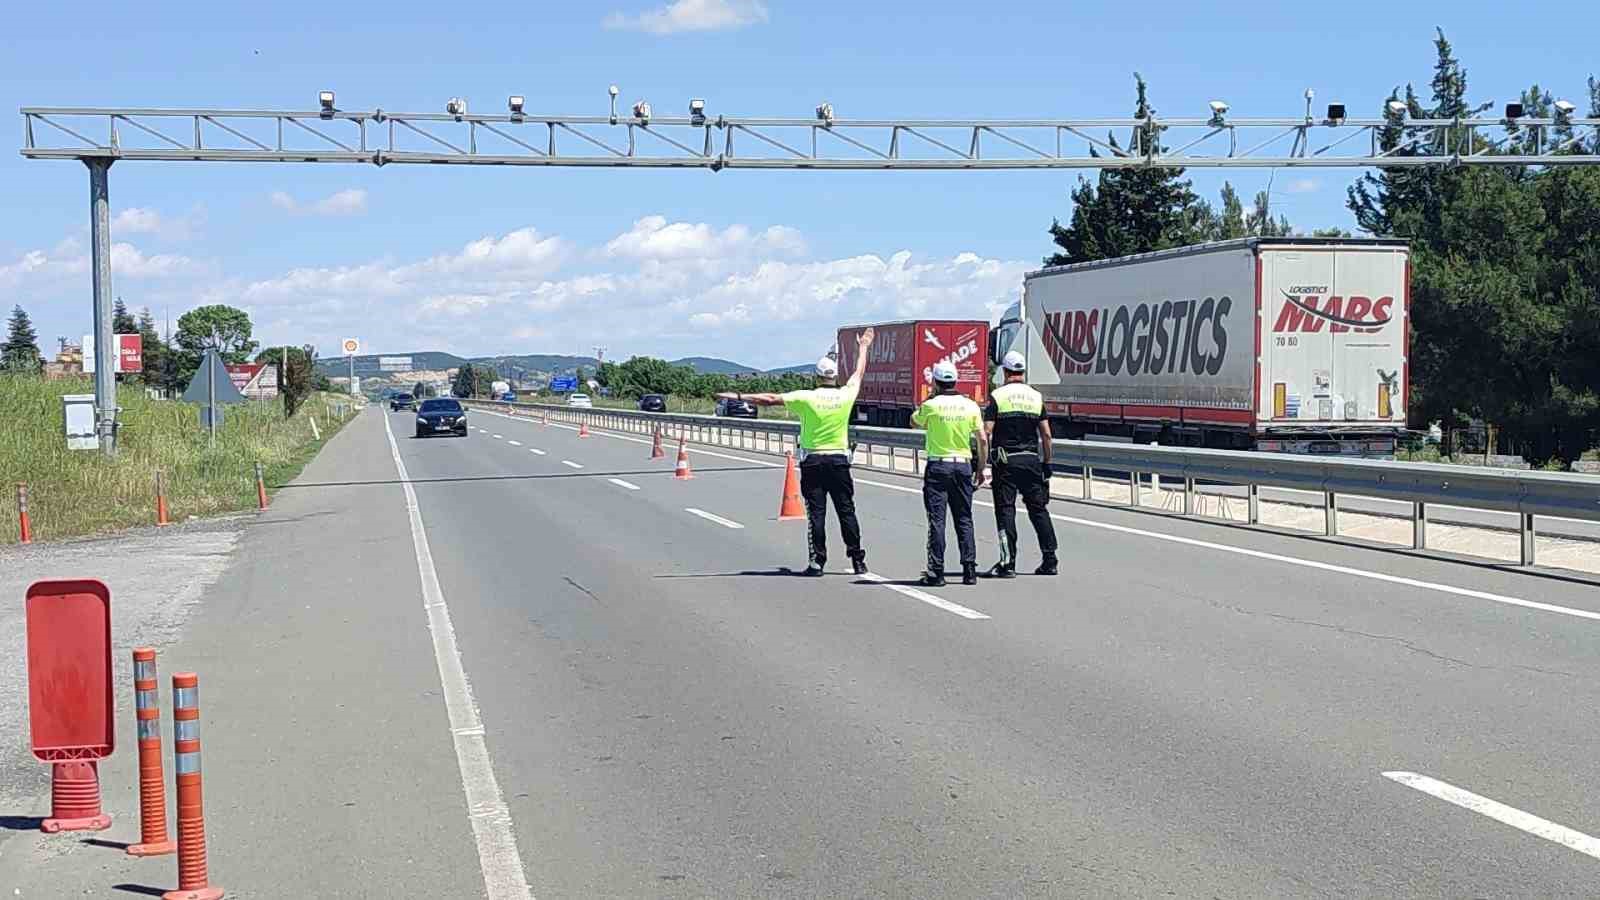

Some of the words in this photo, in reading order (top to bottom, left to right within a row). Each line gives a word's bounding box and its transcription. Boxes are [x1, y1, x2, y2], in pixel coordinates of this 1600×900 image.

[1289, 286, 1328, 294] LOGISTICS
[1272, 295, 1394, 334] MARS
[1095, 296, 1232, 376] LOGISTICS
